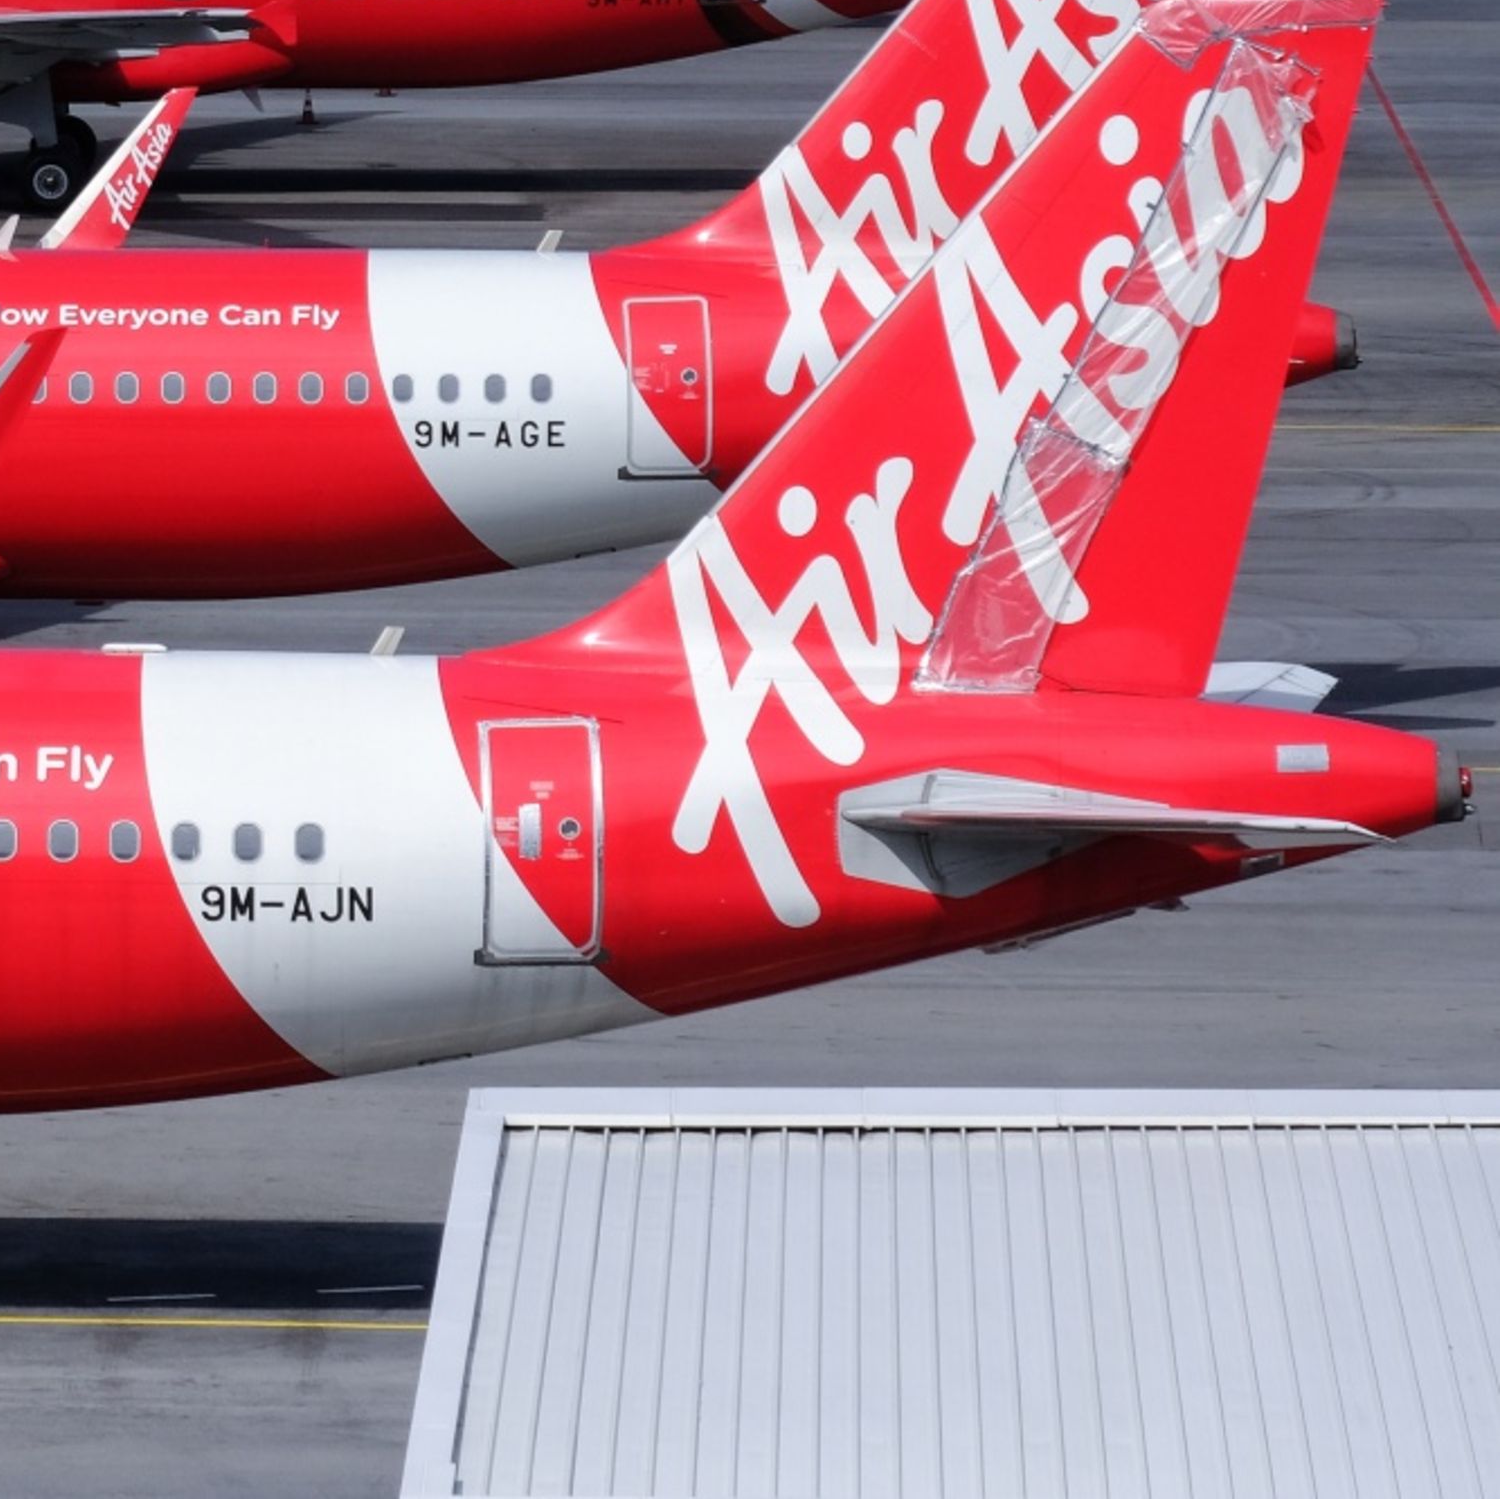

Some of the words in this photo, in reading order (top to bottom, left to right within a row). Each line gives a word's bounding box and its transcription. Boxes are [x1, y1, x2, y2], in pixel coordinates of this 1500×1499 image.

[59, 304, 209, 331] Everyone
[219, 303, 282, 327] Can
[291, 303, 340, 330] Fly
[414, 420, 566, 448] 9M-AGE
[35, 745, 114, 790] Fly
[200, 885, 374, 923] 9M-AJN
